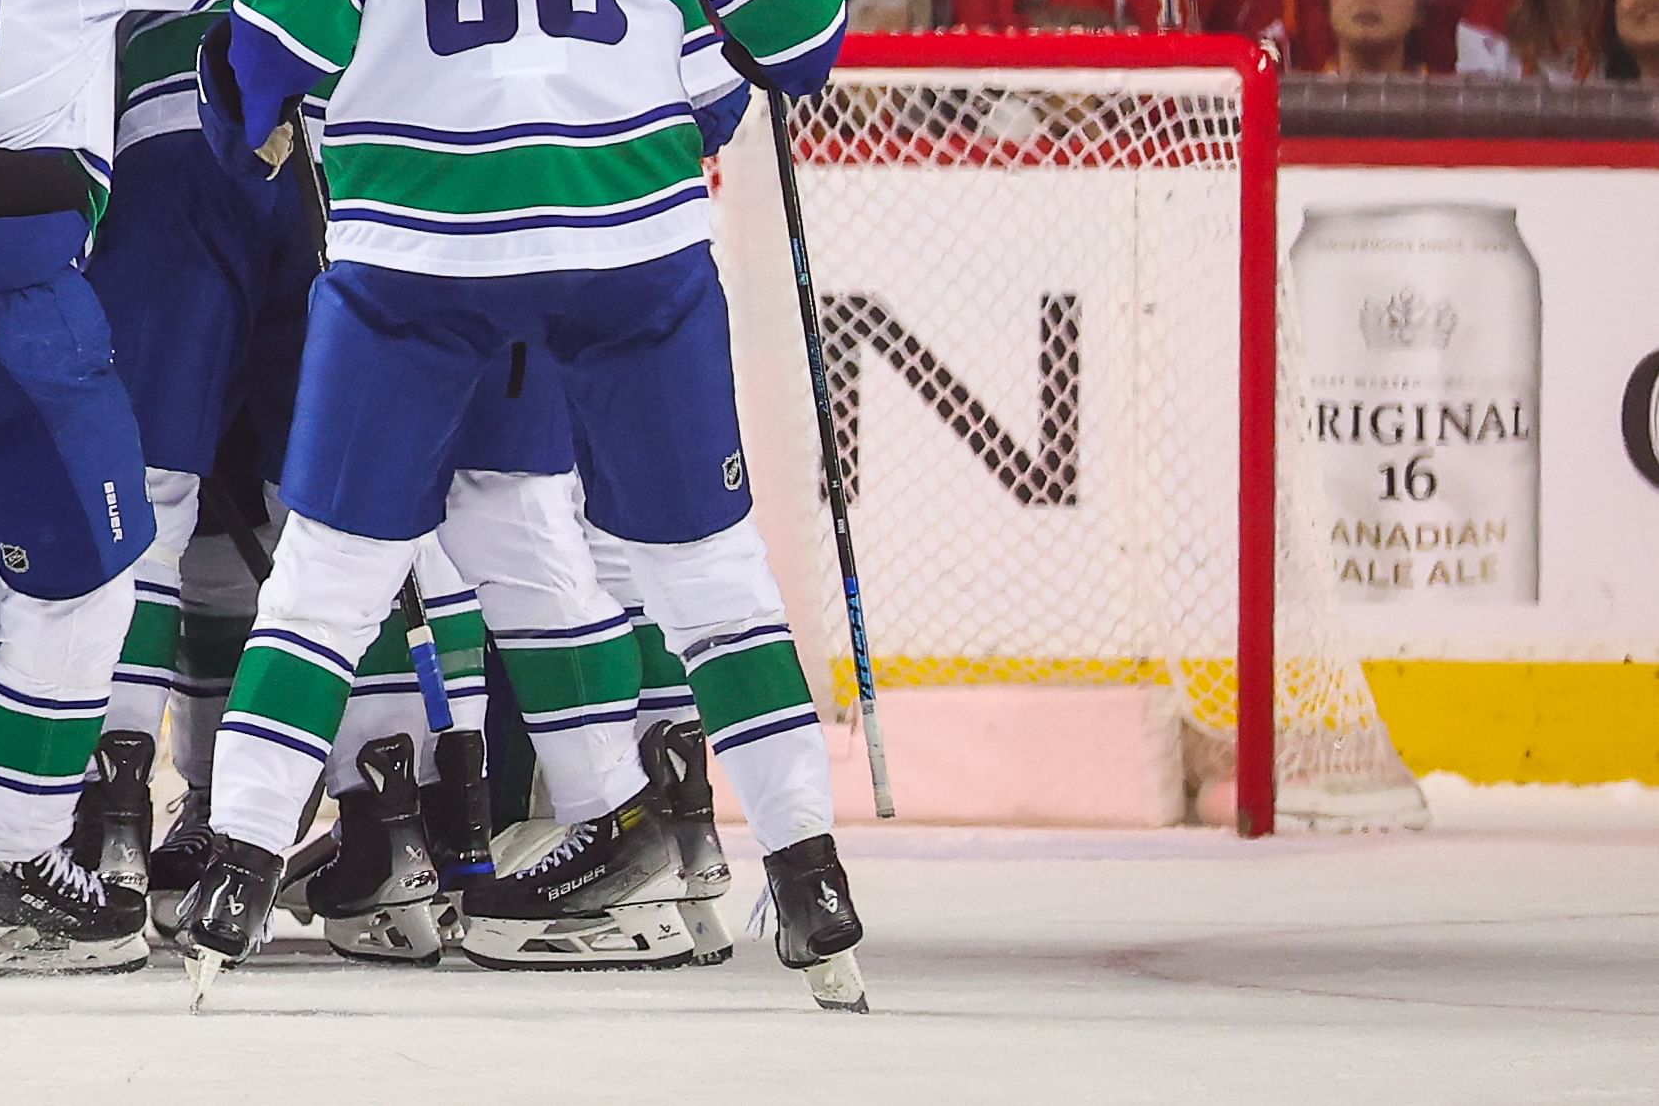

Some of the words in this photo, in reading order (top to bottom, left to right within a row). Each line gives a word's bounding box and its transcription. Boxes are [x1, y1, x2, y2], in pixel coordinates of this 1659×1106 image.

[1309, 399, 1530, 446] RIGINAL
[1378, 446, 1437, 503] 16
[103, 481, 123, 544] BAUER
[1330, 516, 1508, 552] ANADIAN
[1333, 556, 1414, 590] ALE
[1427, 553, 1499, 587] ALE
[547, 863, 607, 902] BAUER
